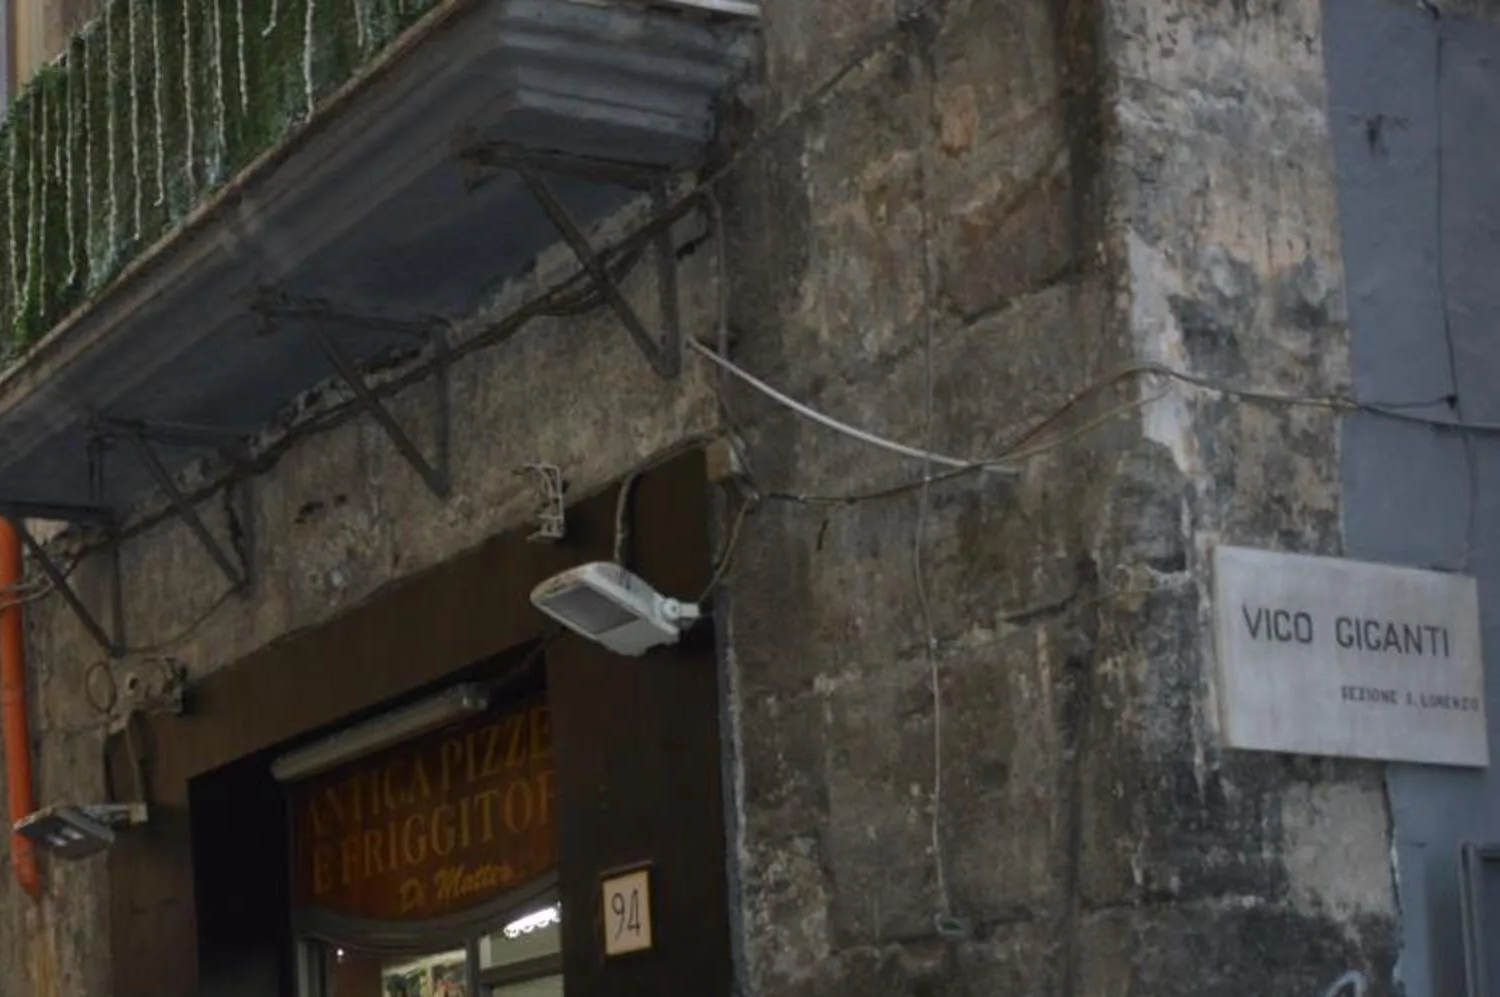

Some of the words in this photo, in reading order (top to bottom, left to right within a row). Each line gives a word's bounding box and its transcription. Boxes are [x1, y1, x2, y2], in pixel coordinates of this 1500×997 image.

[1241, 604, 1314, 645] VICO
[1335, 616, 1451, 658] GIGANTI
[306, 755, 430, 835] ANTICA
[312, 842, 334, 894] E
[611, 888, 640, 941] 94
